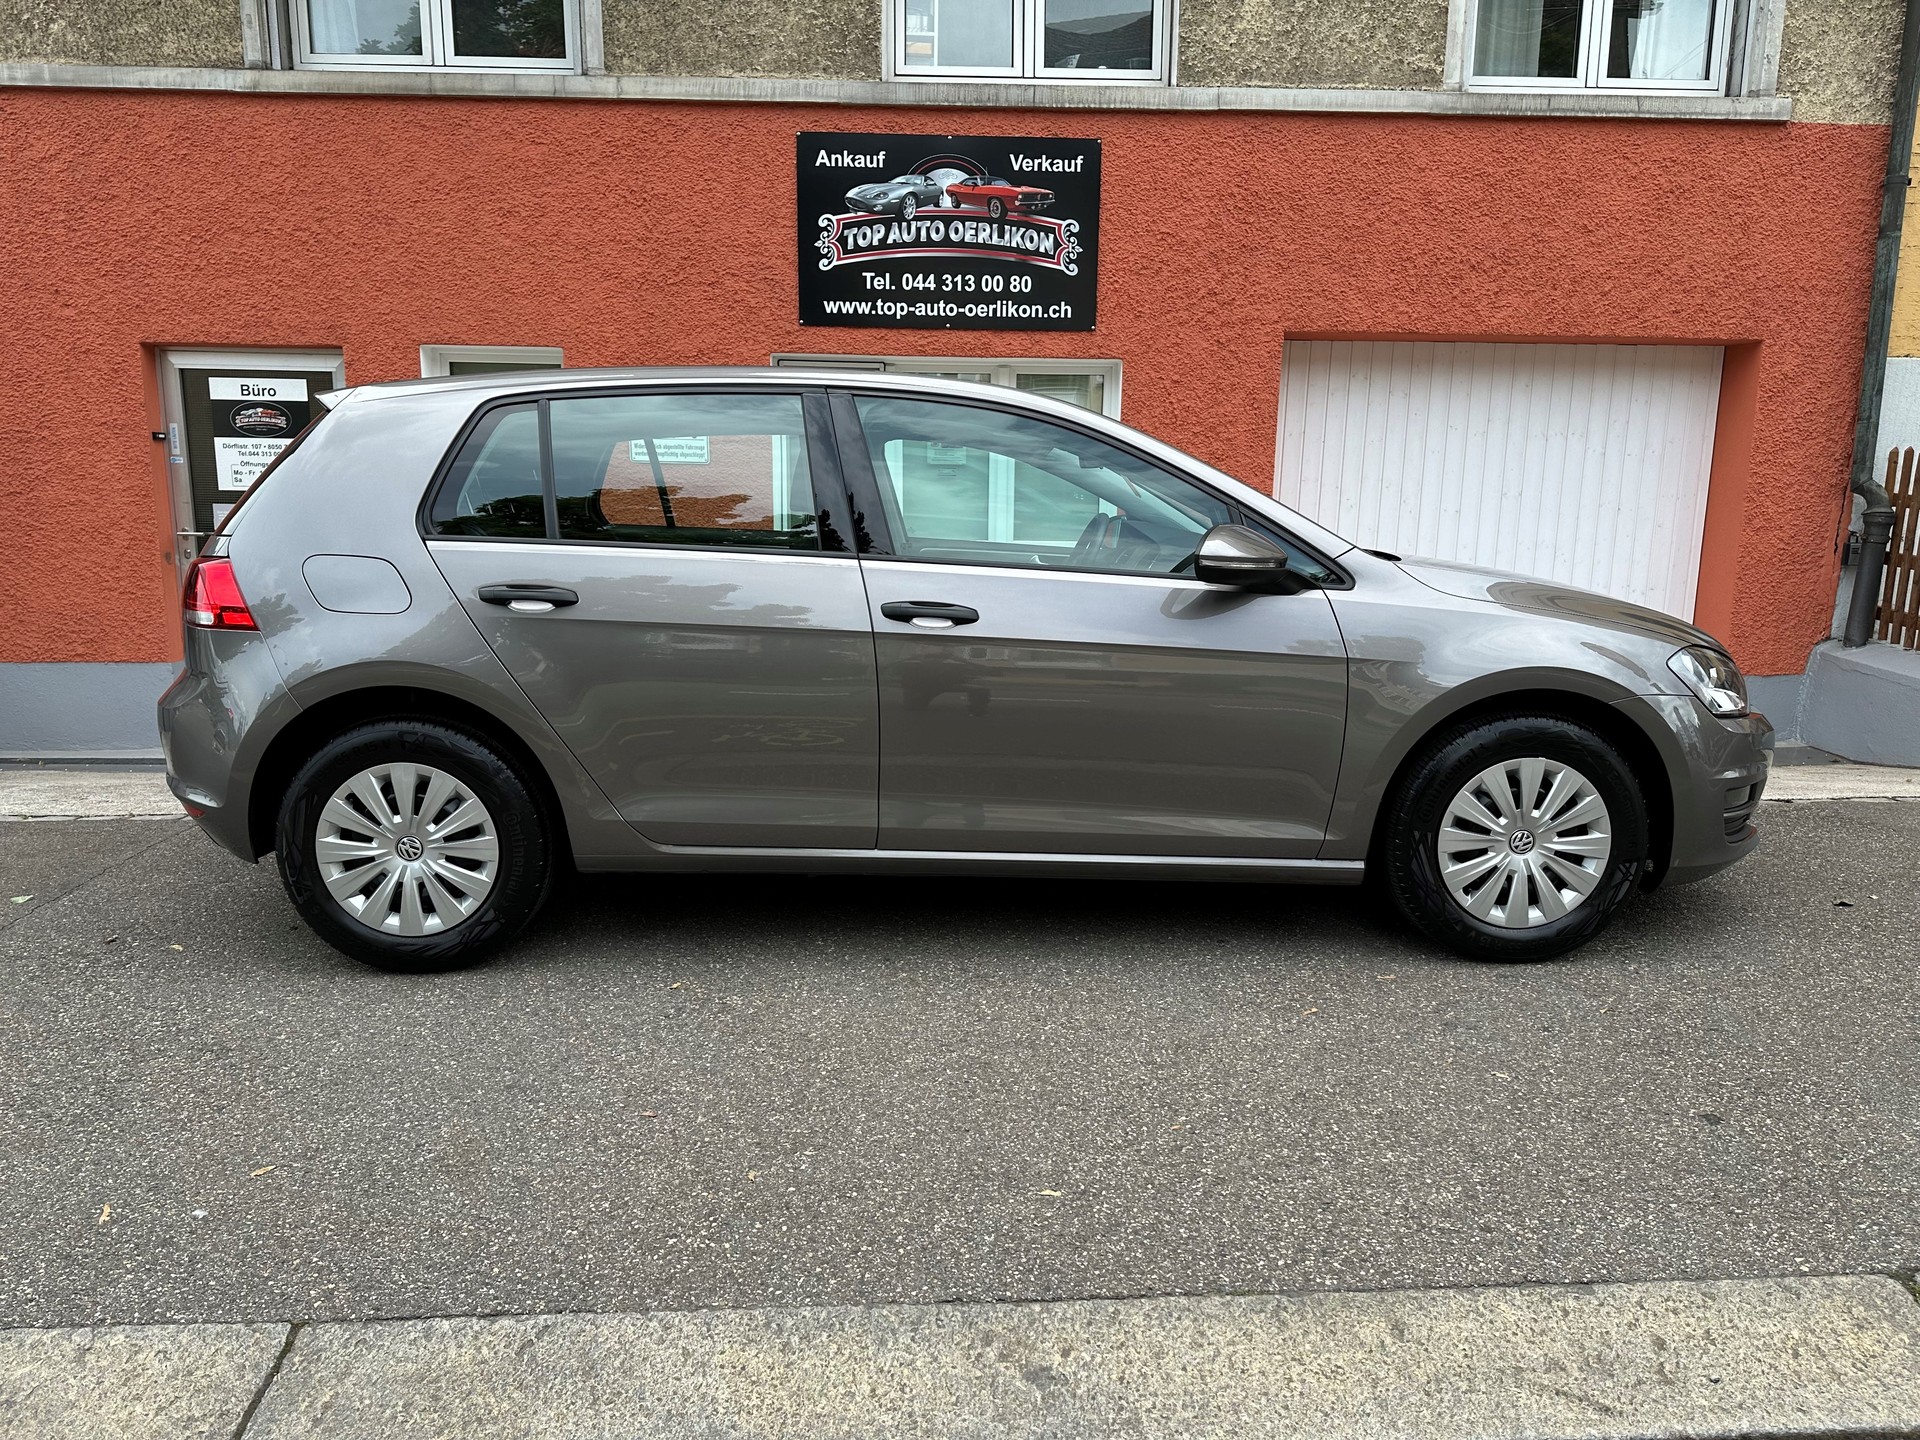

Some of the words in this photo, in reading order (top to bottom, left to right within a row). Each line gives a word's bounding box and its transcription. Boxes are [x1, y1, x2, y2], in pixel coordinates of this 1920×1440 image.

[815, 149, 886, 168] Ankauf
[1009, 153, 1084, 173] Verkauf
[843, 225, 886, 250] TOP
[886, 220, 946, 244] AUTO
[948, 220, 1055, 255] OERLIKON
[862, 272, 896, 290] Tel.
[902, 273, 936, 291] 044
[941, 274, 975, 292] 313
[981, 275, 1007, 293] 00
[1010, 276, 1032, 293] 80
[823, 298, 1072, 320] www.top-auto-oerlikon.ch
[239, 384, 277, 398] Büro
[239, 460, 269, 468] Öffnungs
